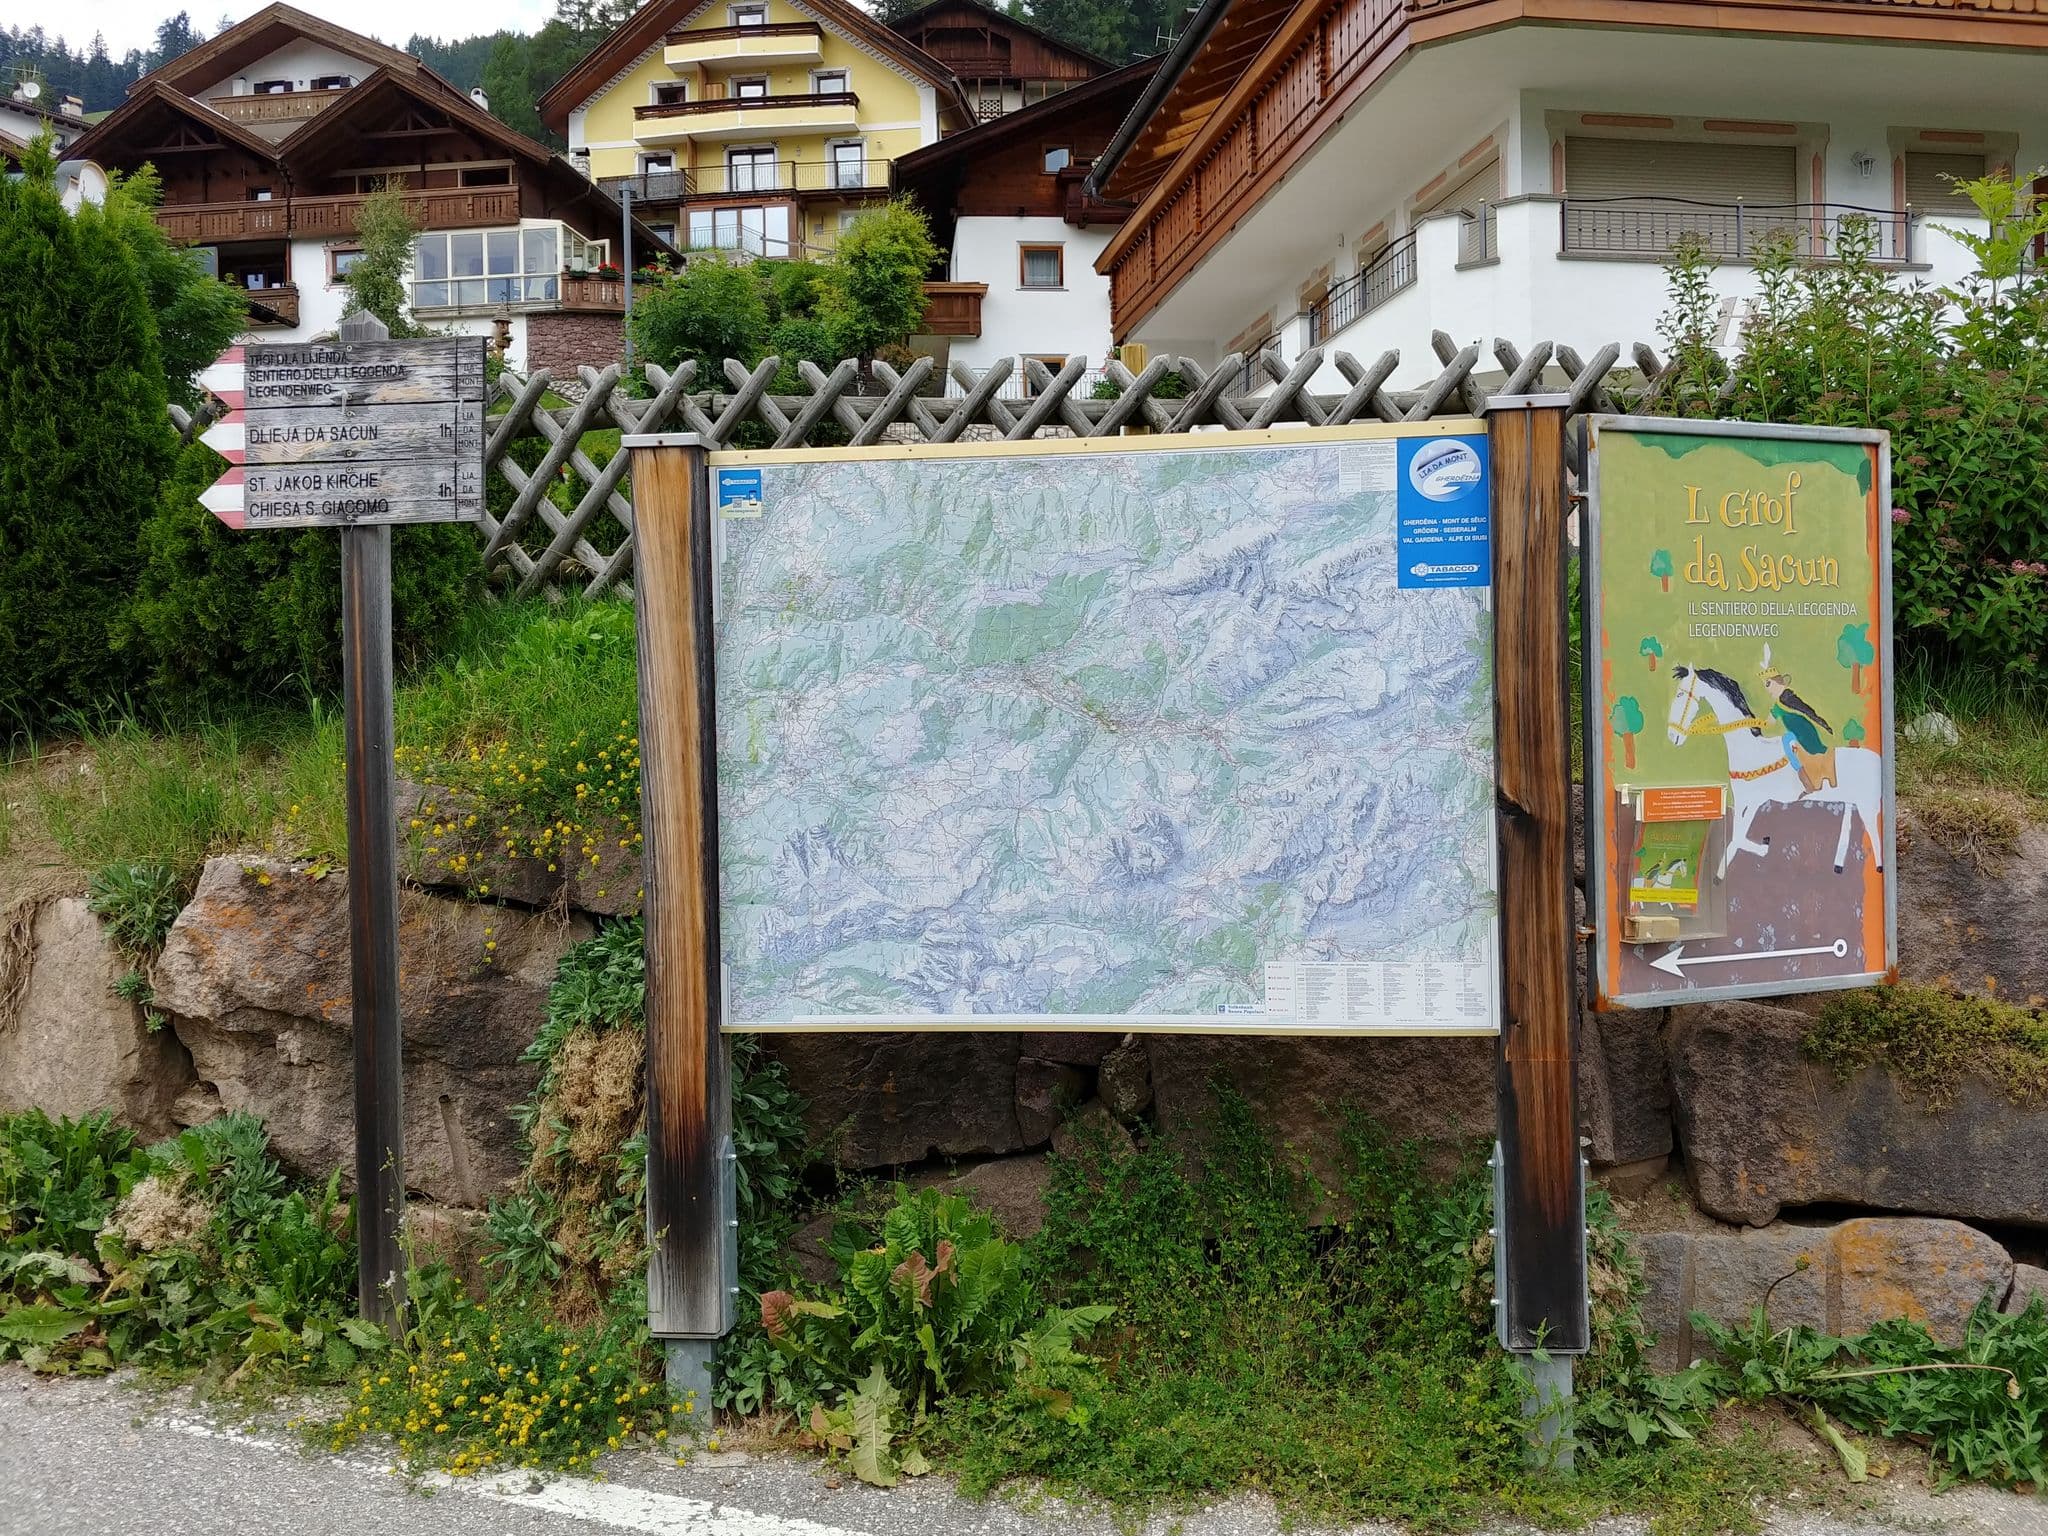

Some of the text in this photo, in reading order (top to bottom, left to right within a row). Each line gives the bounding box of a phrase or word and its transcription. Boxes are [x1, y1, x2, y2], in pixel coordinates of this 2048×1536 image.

[249, 365, 406, 382] SENTIERO DELLA LEGGENDA
[248, 384, 332, 398] LEGENDENWEG
[462, 412, 474, 420] LIA
[249, 425, 378, 444] DLIEJA DA SACUN
[440, 423, 452, 438] 1h
[463, 426, 474, 434] DA
[458, 439, 478, 448] MONT
[1419, 452, 1467, 479] LIA DA MONT
[249, 473, 378, 492] ST. JAKOB KIRCHE
[462, 472, 474, 480] LIA
[439, 482, 452, 498] 1h
[463, 485, 474, 493] DA
[249, 498, 389, 518] CHIESA S. GIACOMO
[458, 499, 478, 507] MONT
[1683, 470, 1801, 536] L Grof
[1431, 565, 1475, 573] TABACCO
[1684, 534, 1840, 592] da Sacun
[1688, 602, 1857, 616] IL SENTIERO DELLA LEGGENDA
[1689, 623, 1779, 637] LEGENDENWEG
